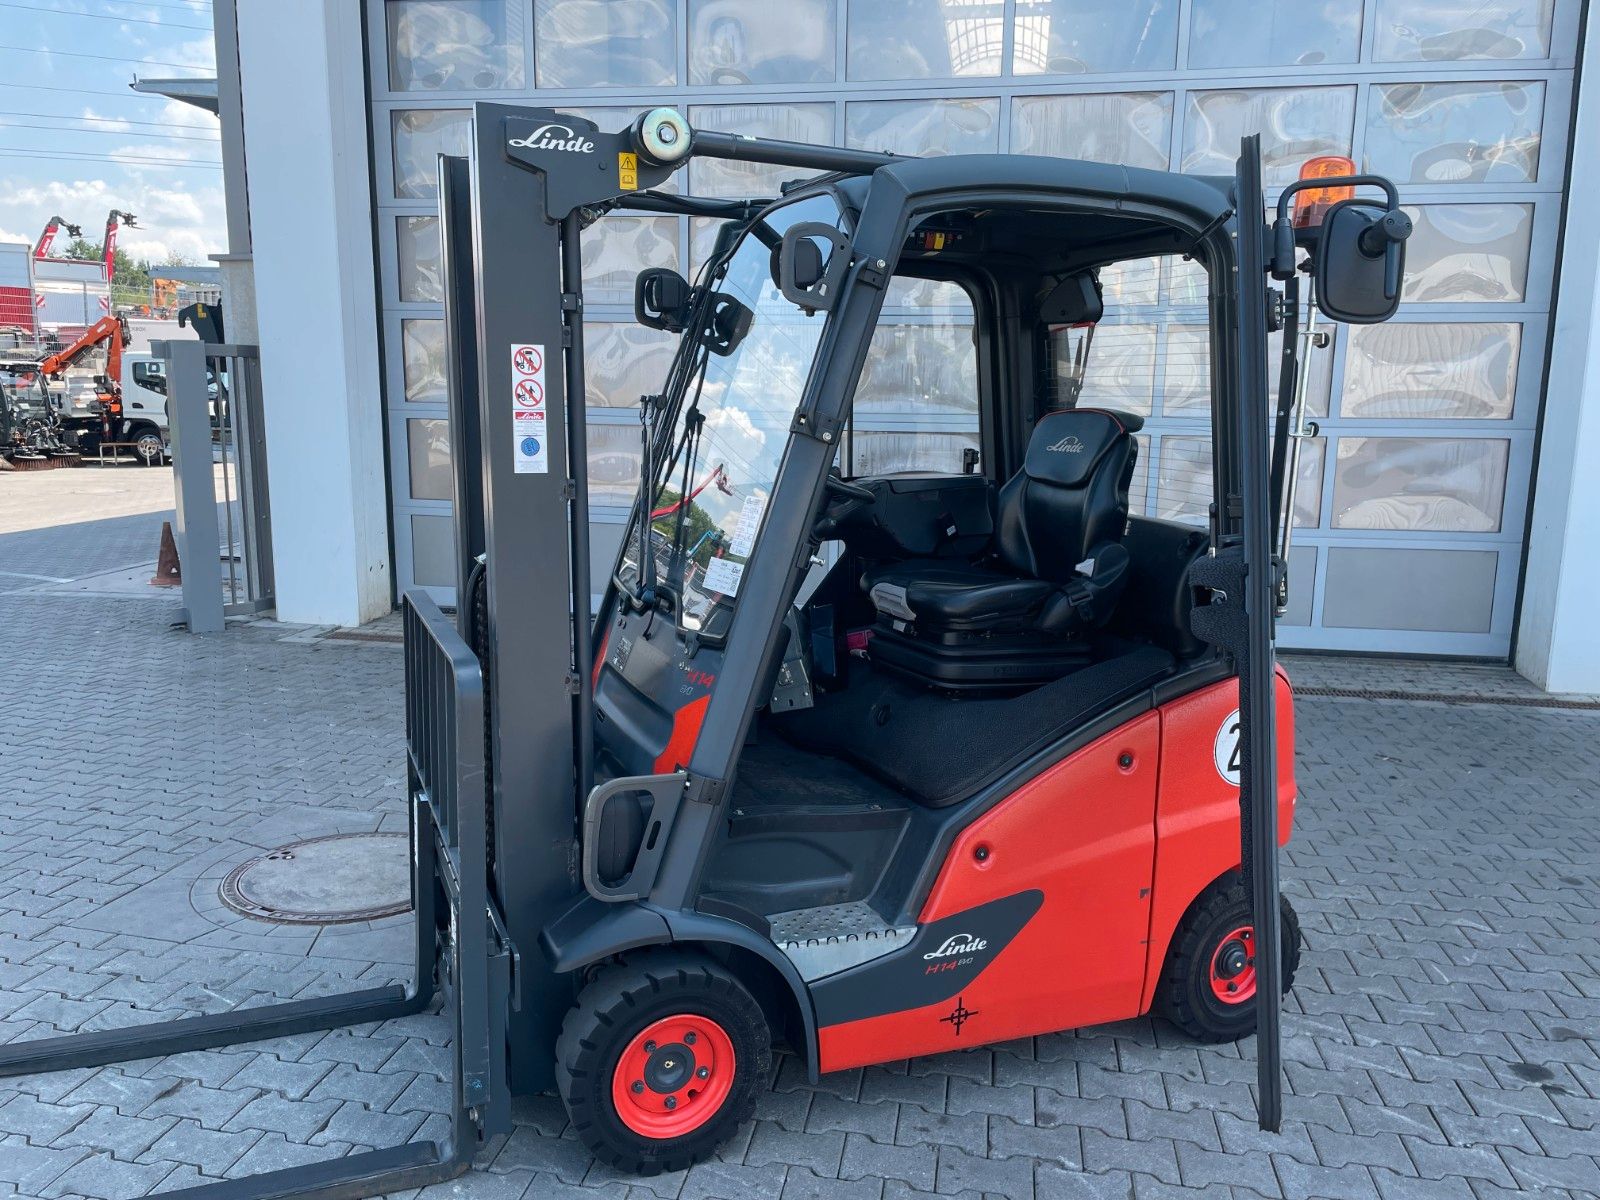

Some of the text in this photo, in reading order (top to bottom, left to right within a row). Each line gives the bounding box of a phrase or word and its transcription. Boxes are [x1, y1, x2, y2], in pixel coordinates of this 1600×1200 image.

[508, 124, 595, 154] Linde
[1046, 435, 1084, 453] Linde
[923, 933, 987, 959] Linde
[925, 960, 957, 975] H14
